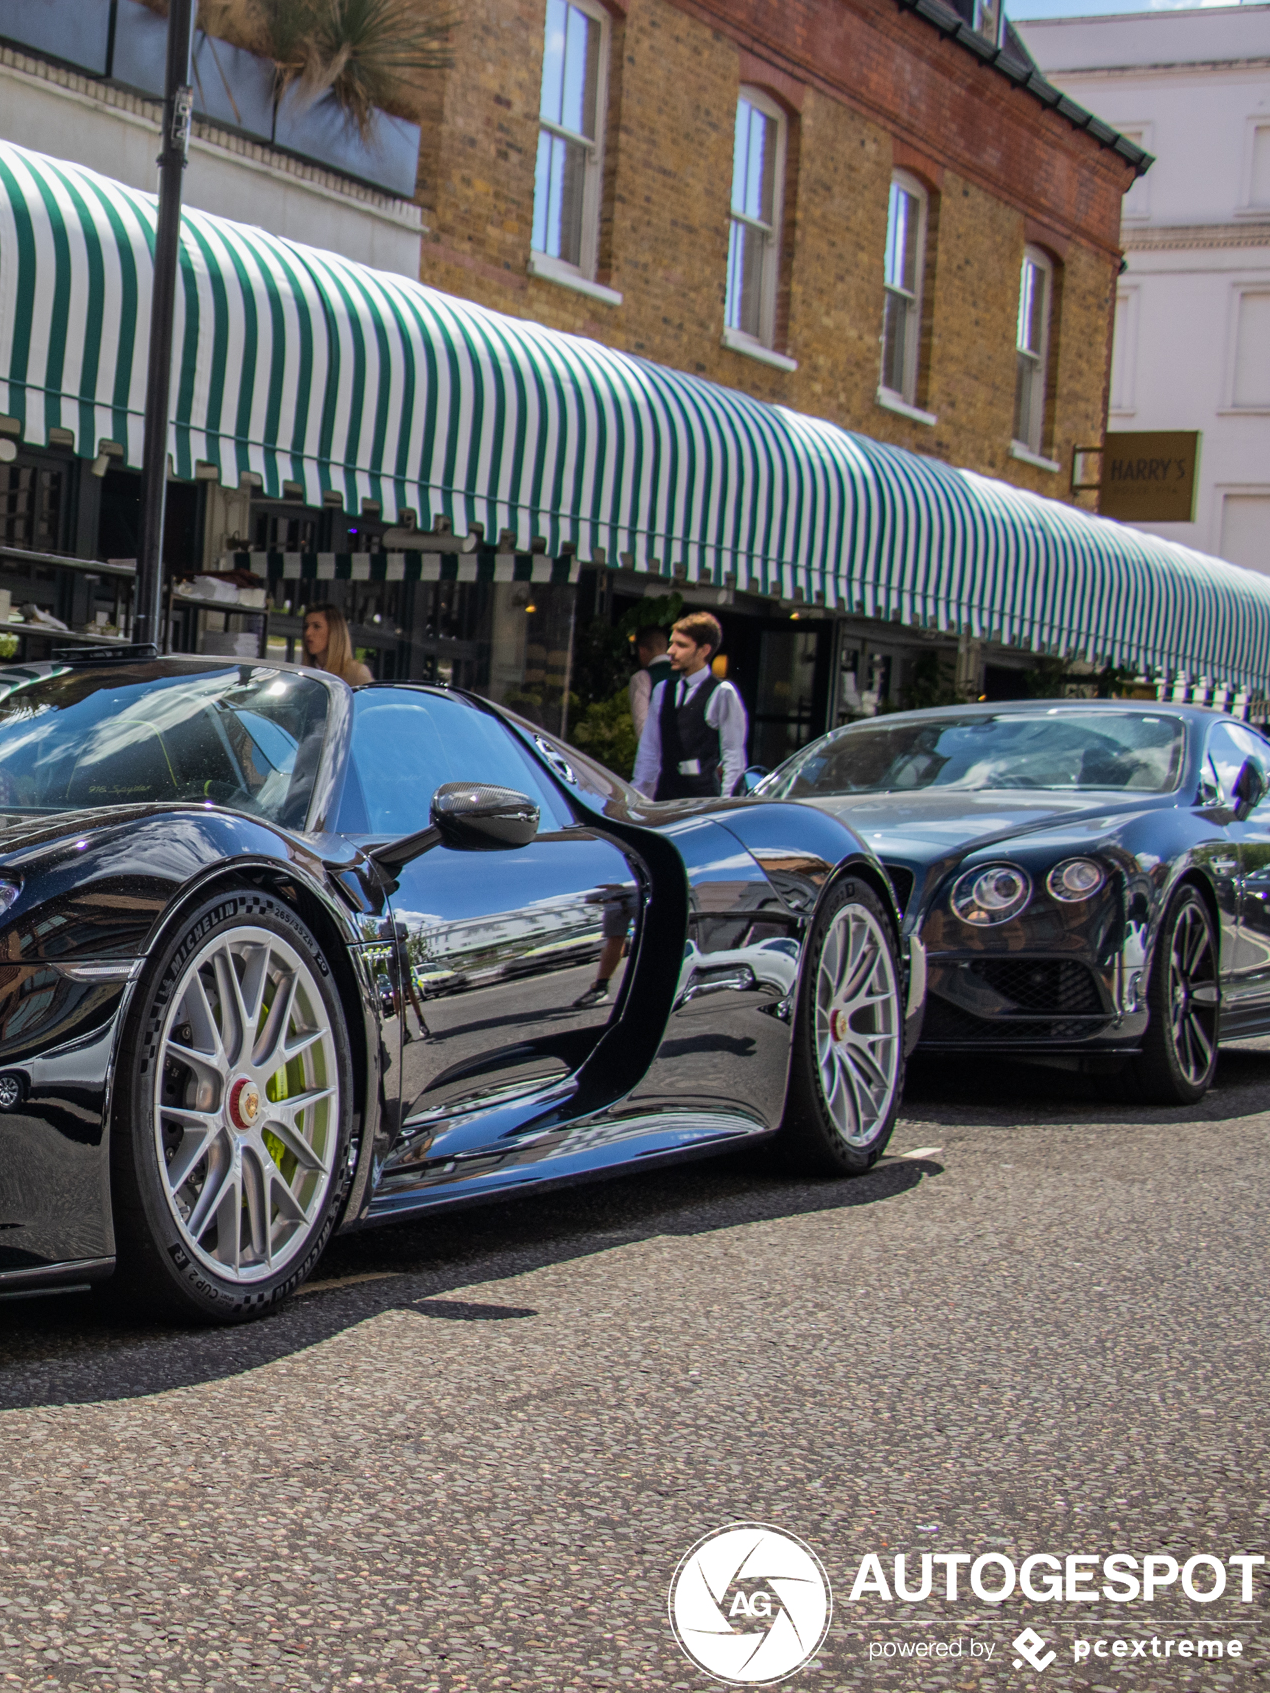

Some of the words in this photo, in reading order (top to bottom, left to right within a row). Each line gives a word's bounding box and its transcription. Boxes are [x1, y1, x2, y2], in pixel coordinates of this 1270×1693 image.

[1111, 457, 1186, 481] HARRY'S
[171, 902, 234, 975] MICHELIN
[174, 1249, 186, 1264] R
[275, 1220, 330, 1300] MICHELIN
[189, 1270, 199, 1281] 2
[196, 1280, 219, 1299] CUP
